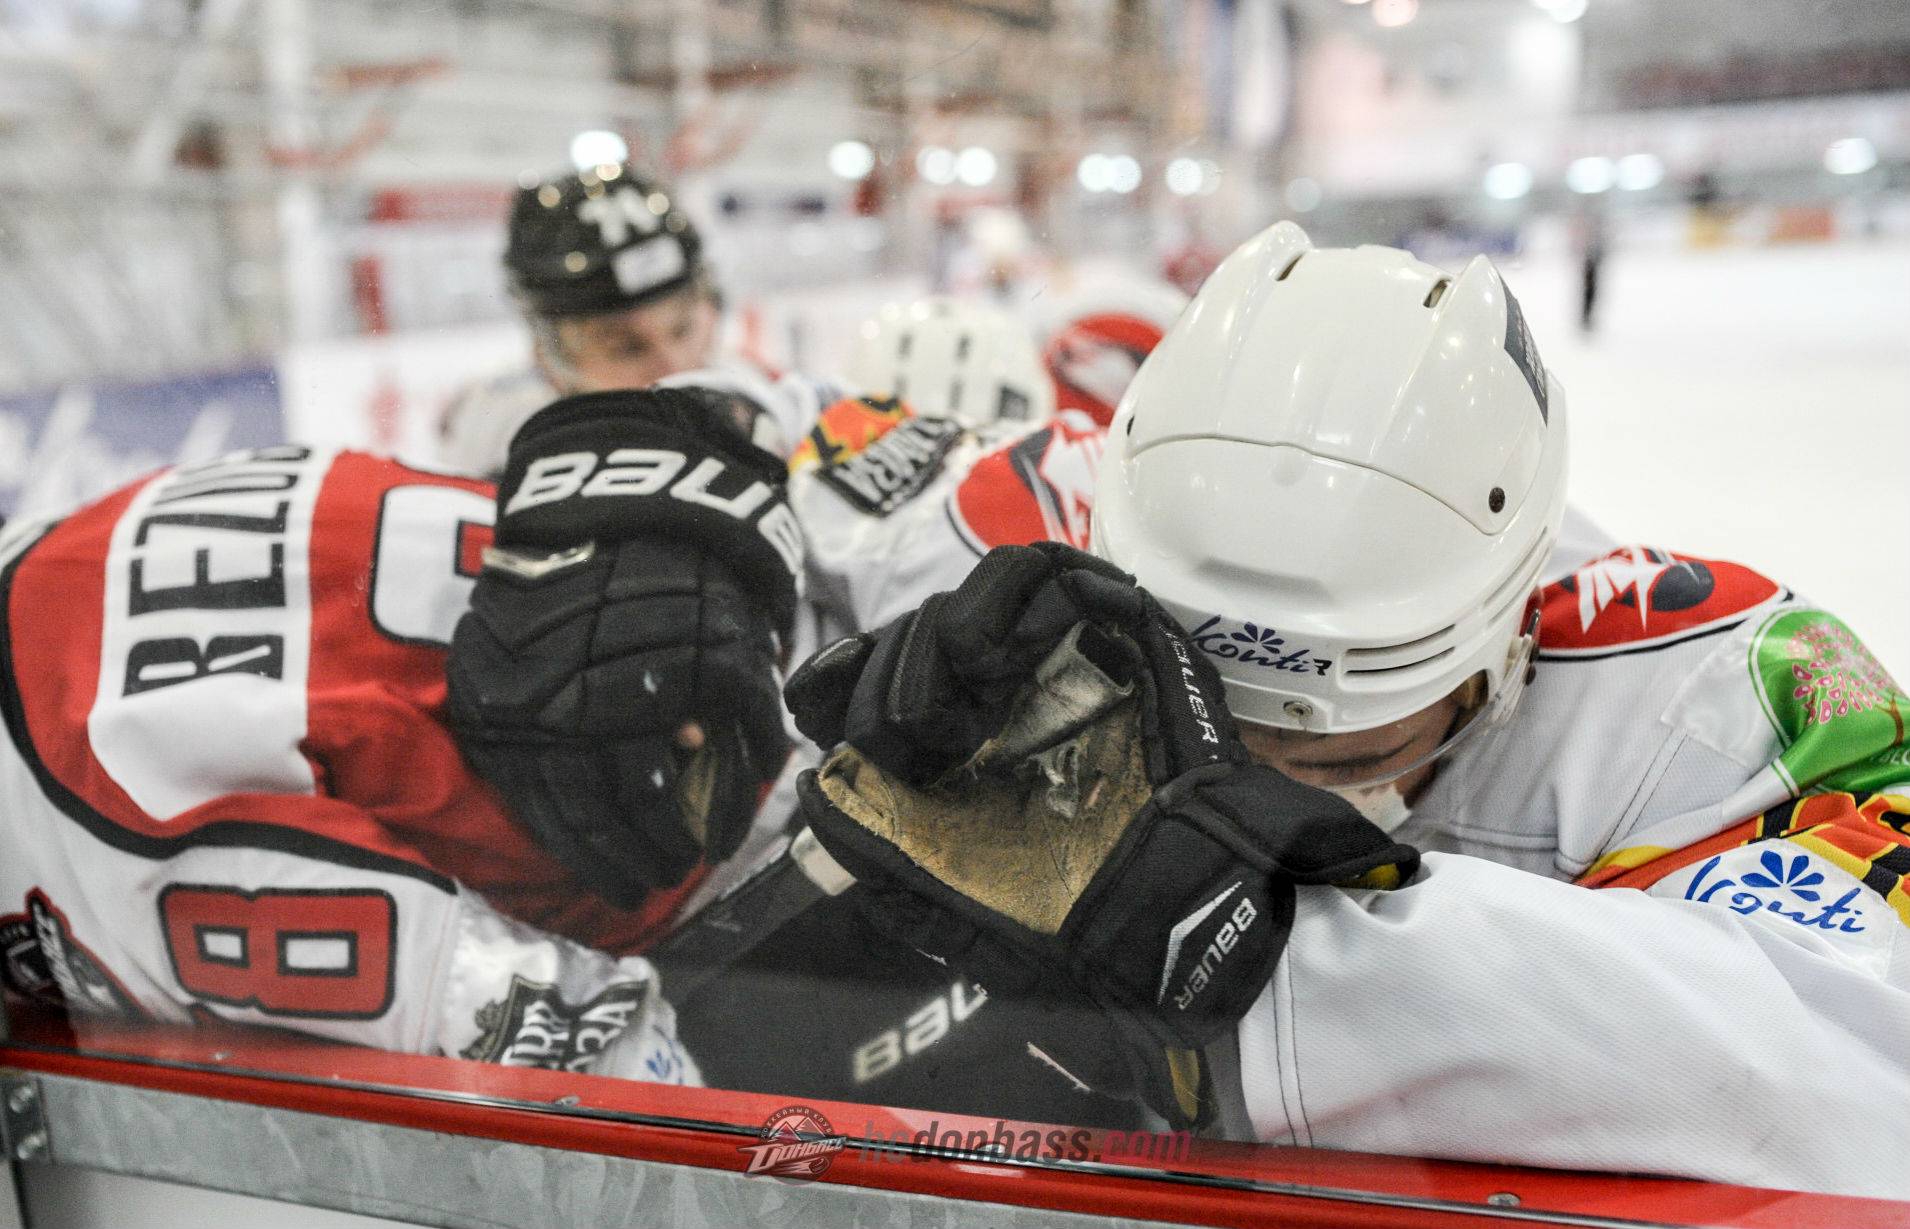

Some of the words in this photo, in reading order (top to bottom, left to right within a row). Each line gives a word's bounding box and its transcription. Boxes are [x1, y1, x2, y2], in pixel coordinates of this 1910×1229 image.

[505, 448, 803, 584] BAUE
[1157, 622, 1219, 744] AUER
[156, 881, 398, 1030] 8
[1174, 897, 1258, 1010] BAUER
[853, 981, 989, 1084] BAU
